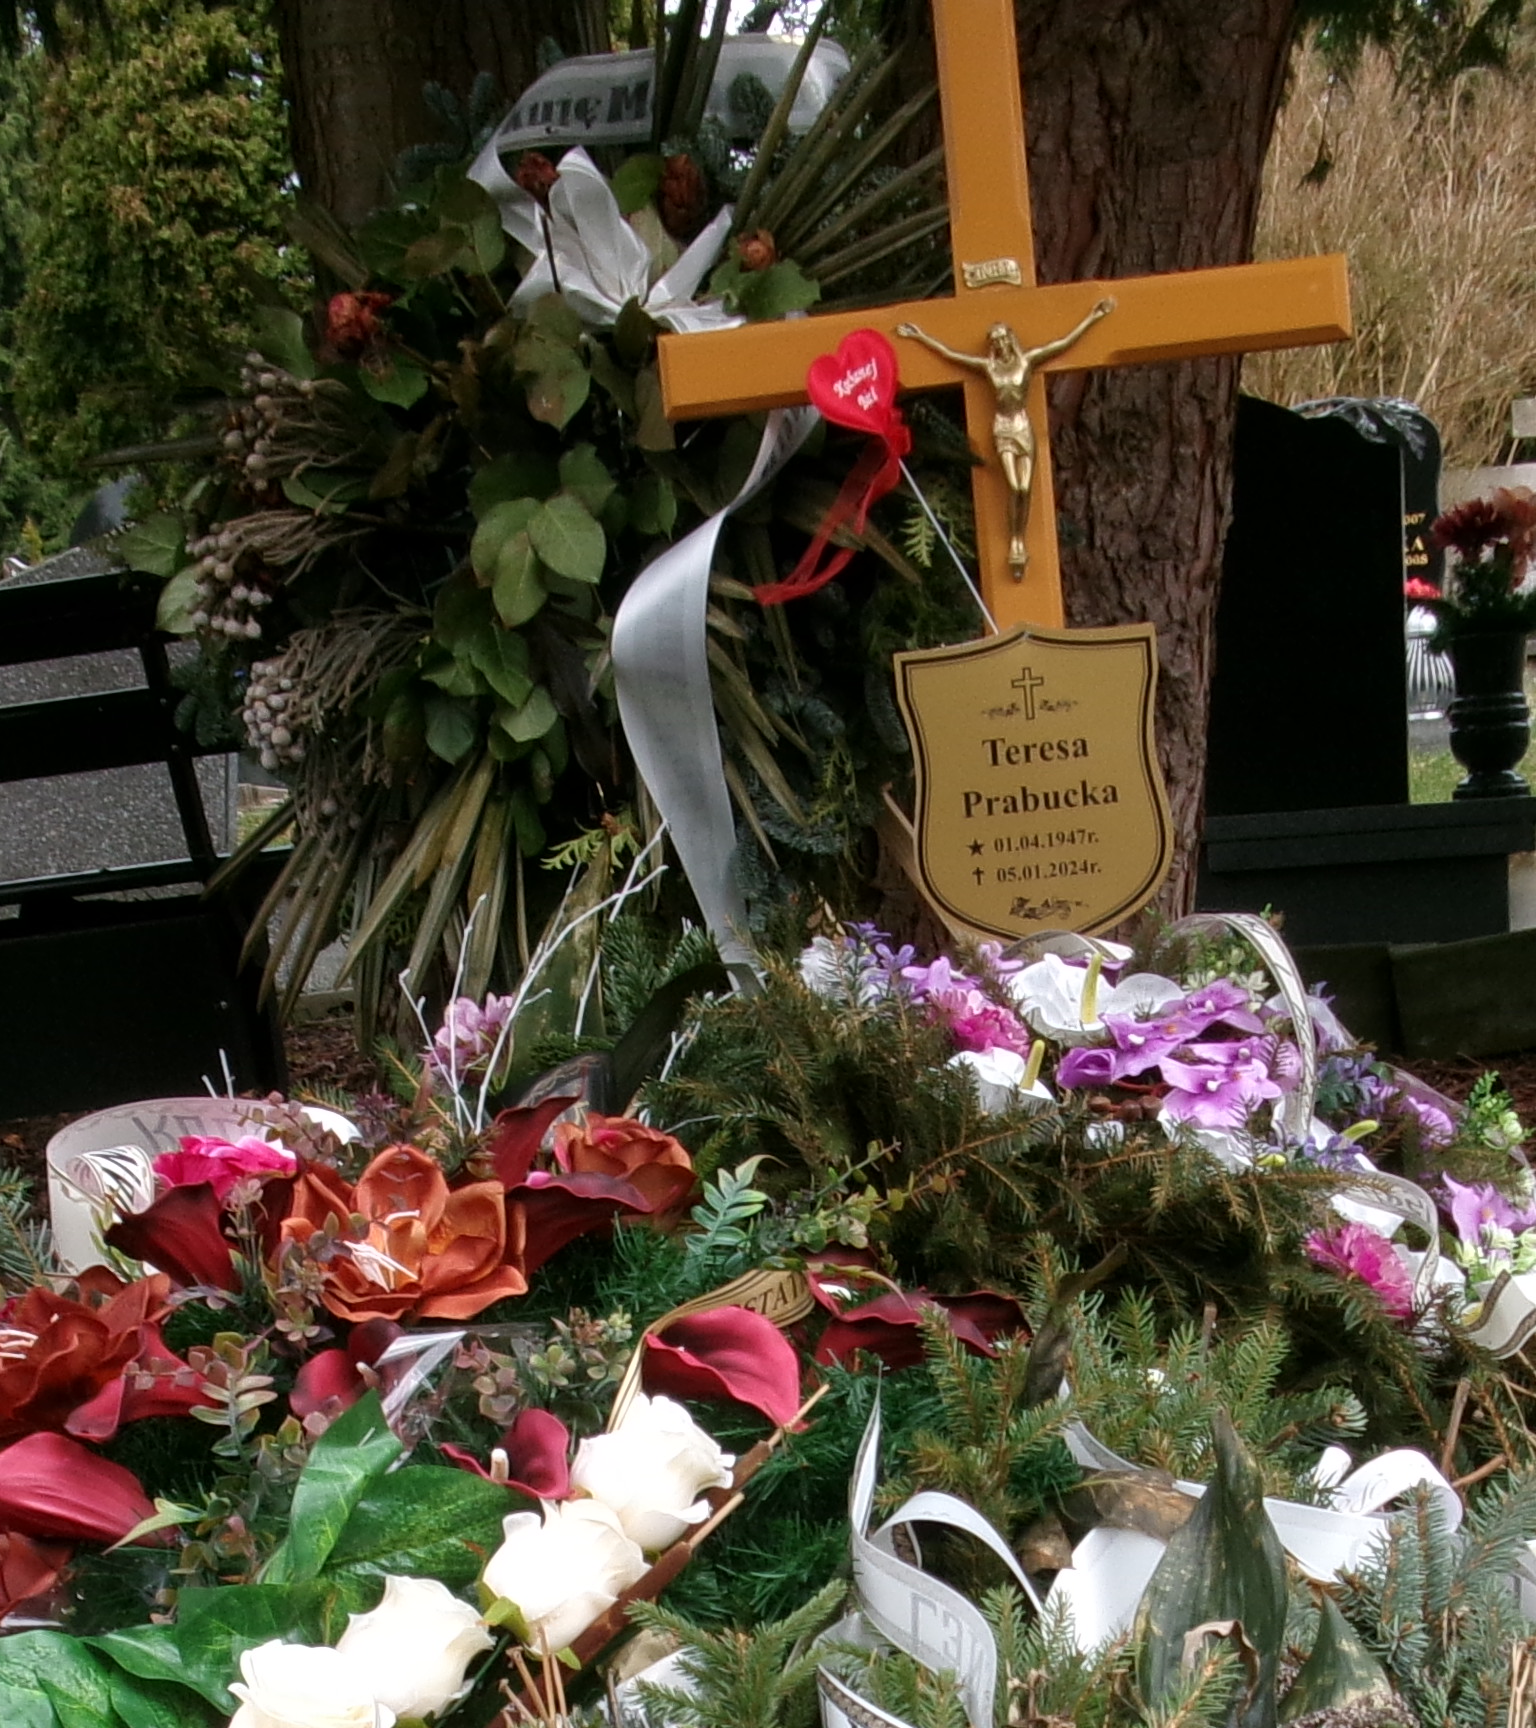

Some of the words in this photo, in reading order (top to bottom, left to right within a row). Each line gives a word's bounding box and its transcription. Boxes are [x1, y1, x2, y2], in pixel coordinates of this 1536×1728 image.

[981, 736, 1090, 767] Teresa
[962, 780, 1119, 819] Prabucka
[993, 829, 1100, 854] 01.04.1947r.
[996, 859, 1102, 884] 05.01.2024r.
